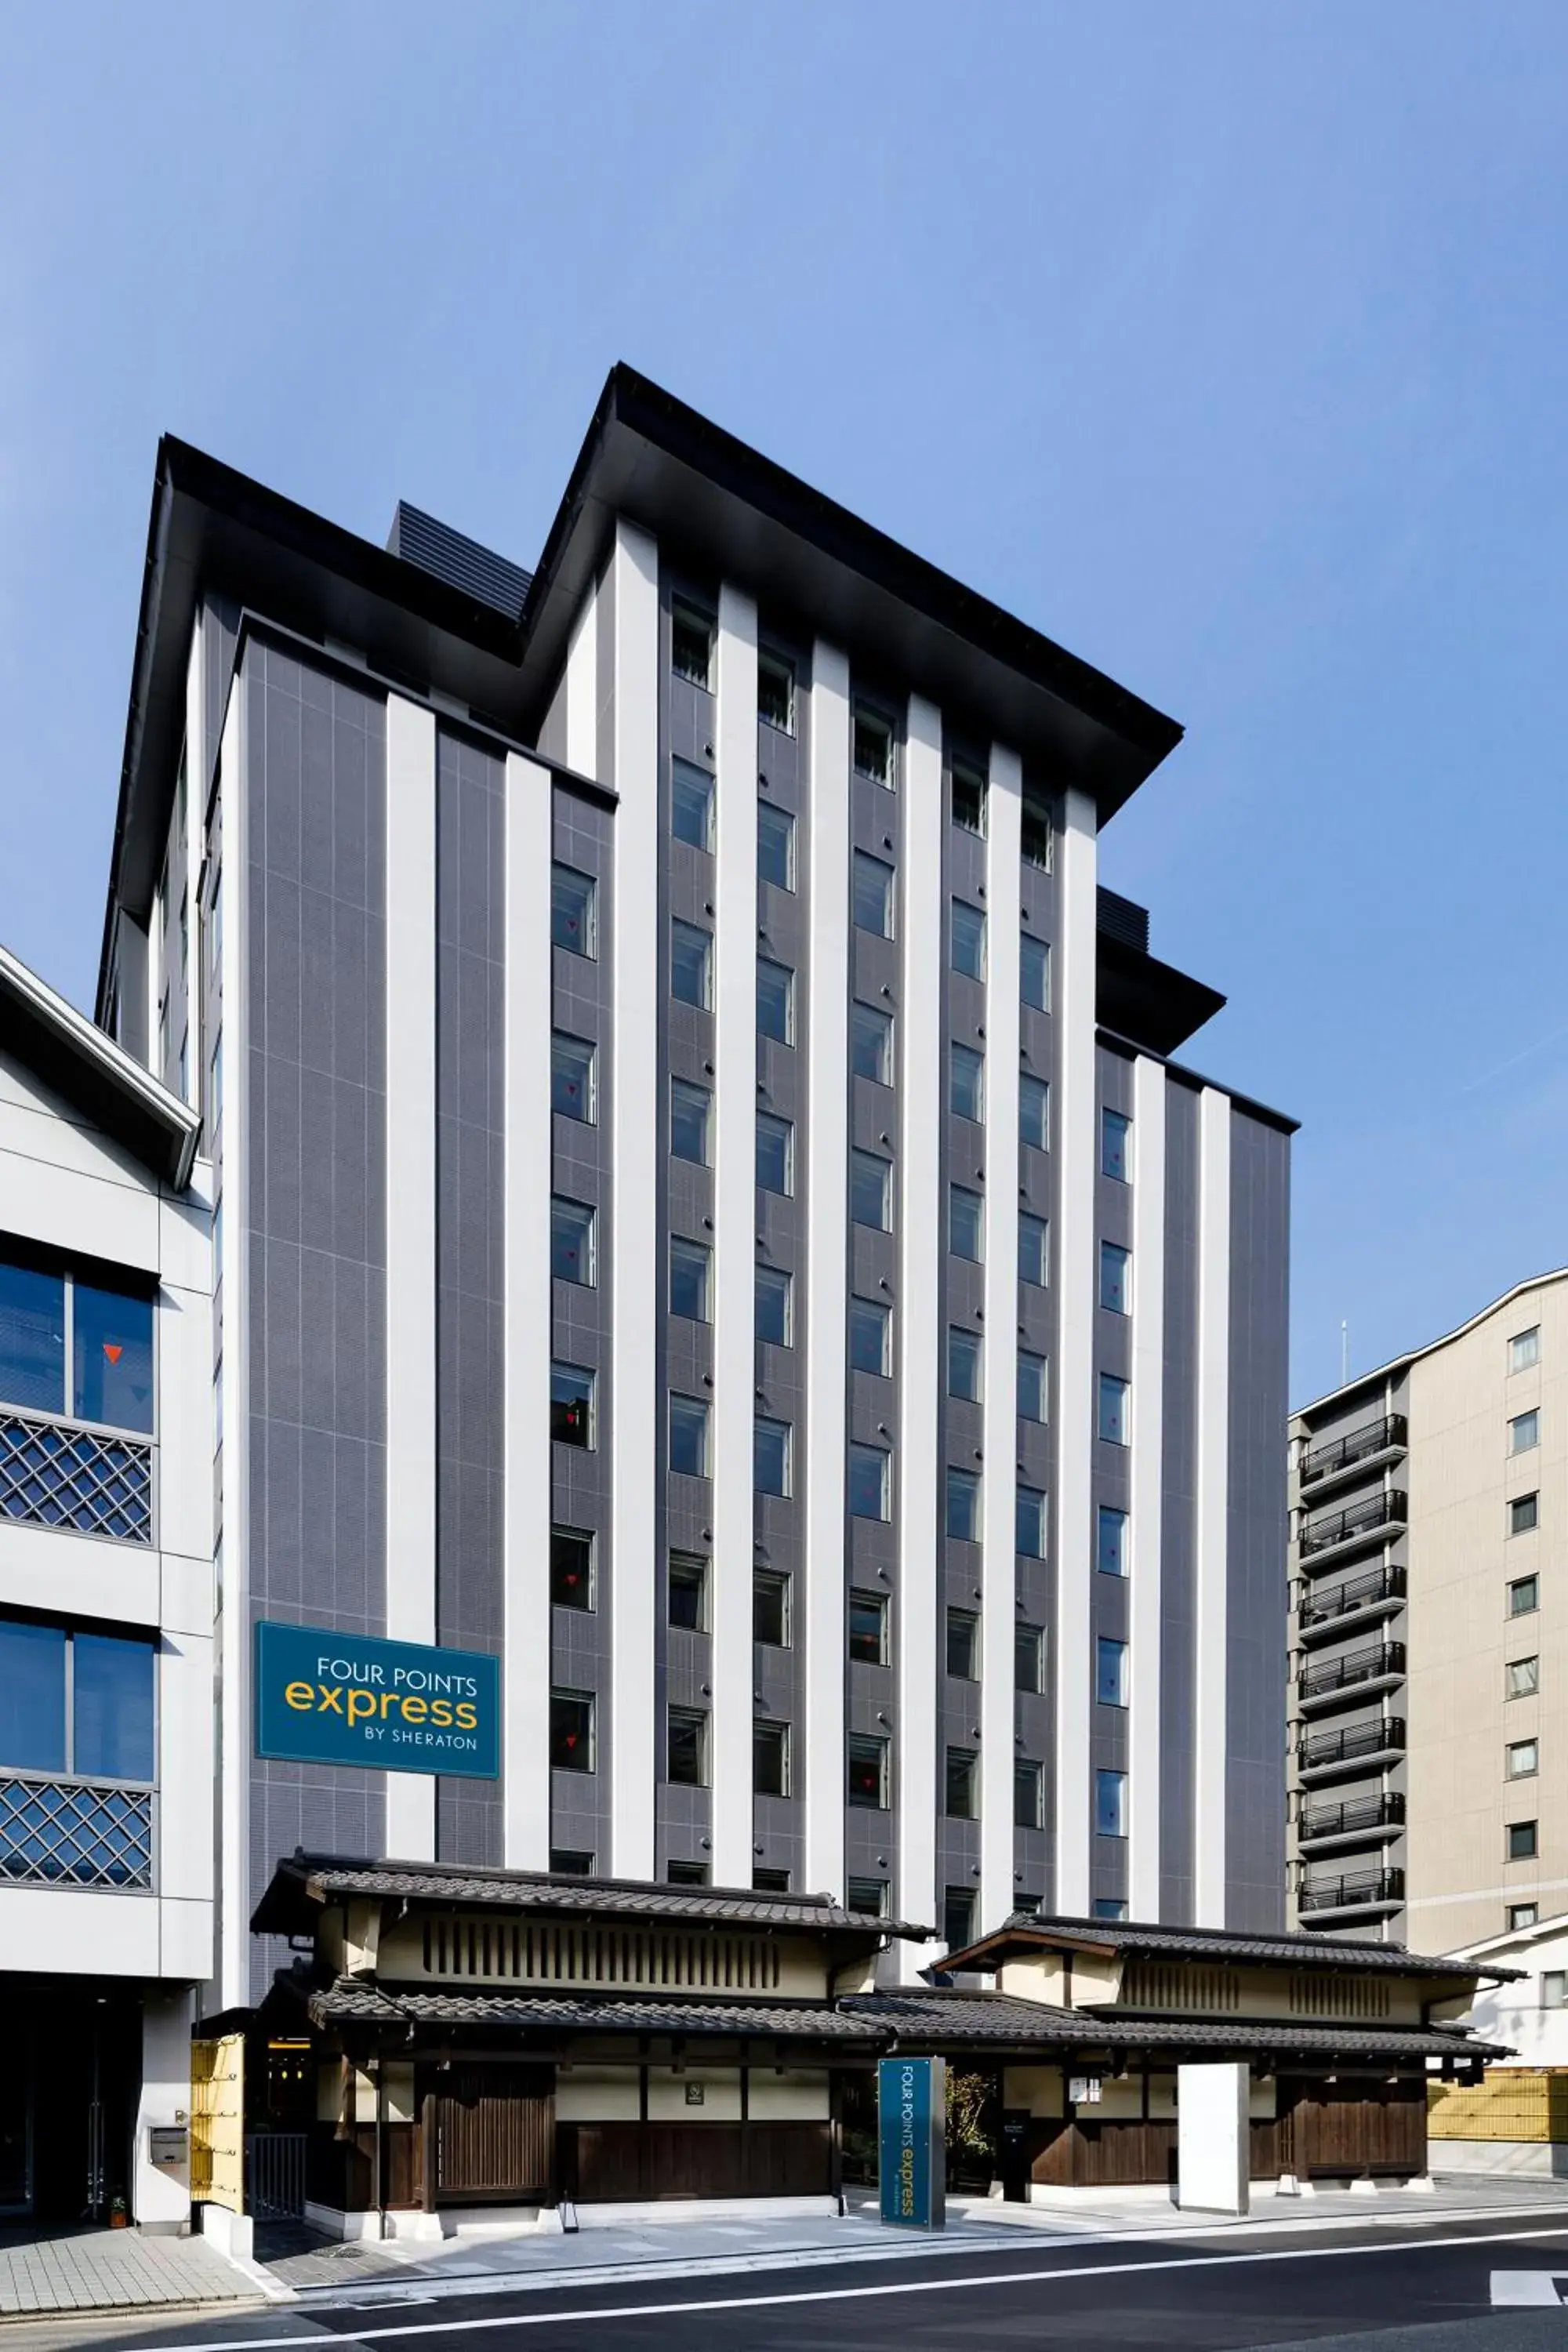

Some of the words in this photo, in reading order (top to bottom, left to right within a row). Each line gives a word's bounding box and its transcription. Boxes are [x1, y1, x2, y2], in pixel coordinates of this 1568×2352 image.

[317, 1657, 385, 1685] FOUR
[394, 1668, 477, 1697] POINTS
[285, 1682, 477, 1729] express
[365, 1726, 385, 1740] BY
[392, 1730, 477, 1750] SHERATON
[902, 2066, 913, 2100] FOUR
[902, 2103, 913, 2146] POINTS
[898, 2149, 913, 2216] express
